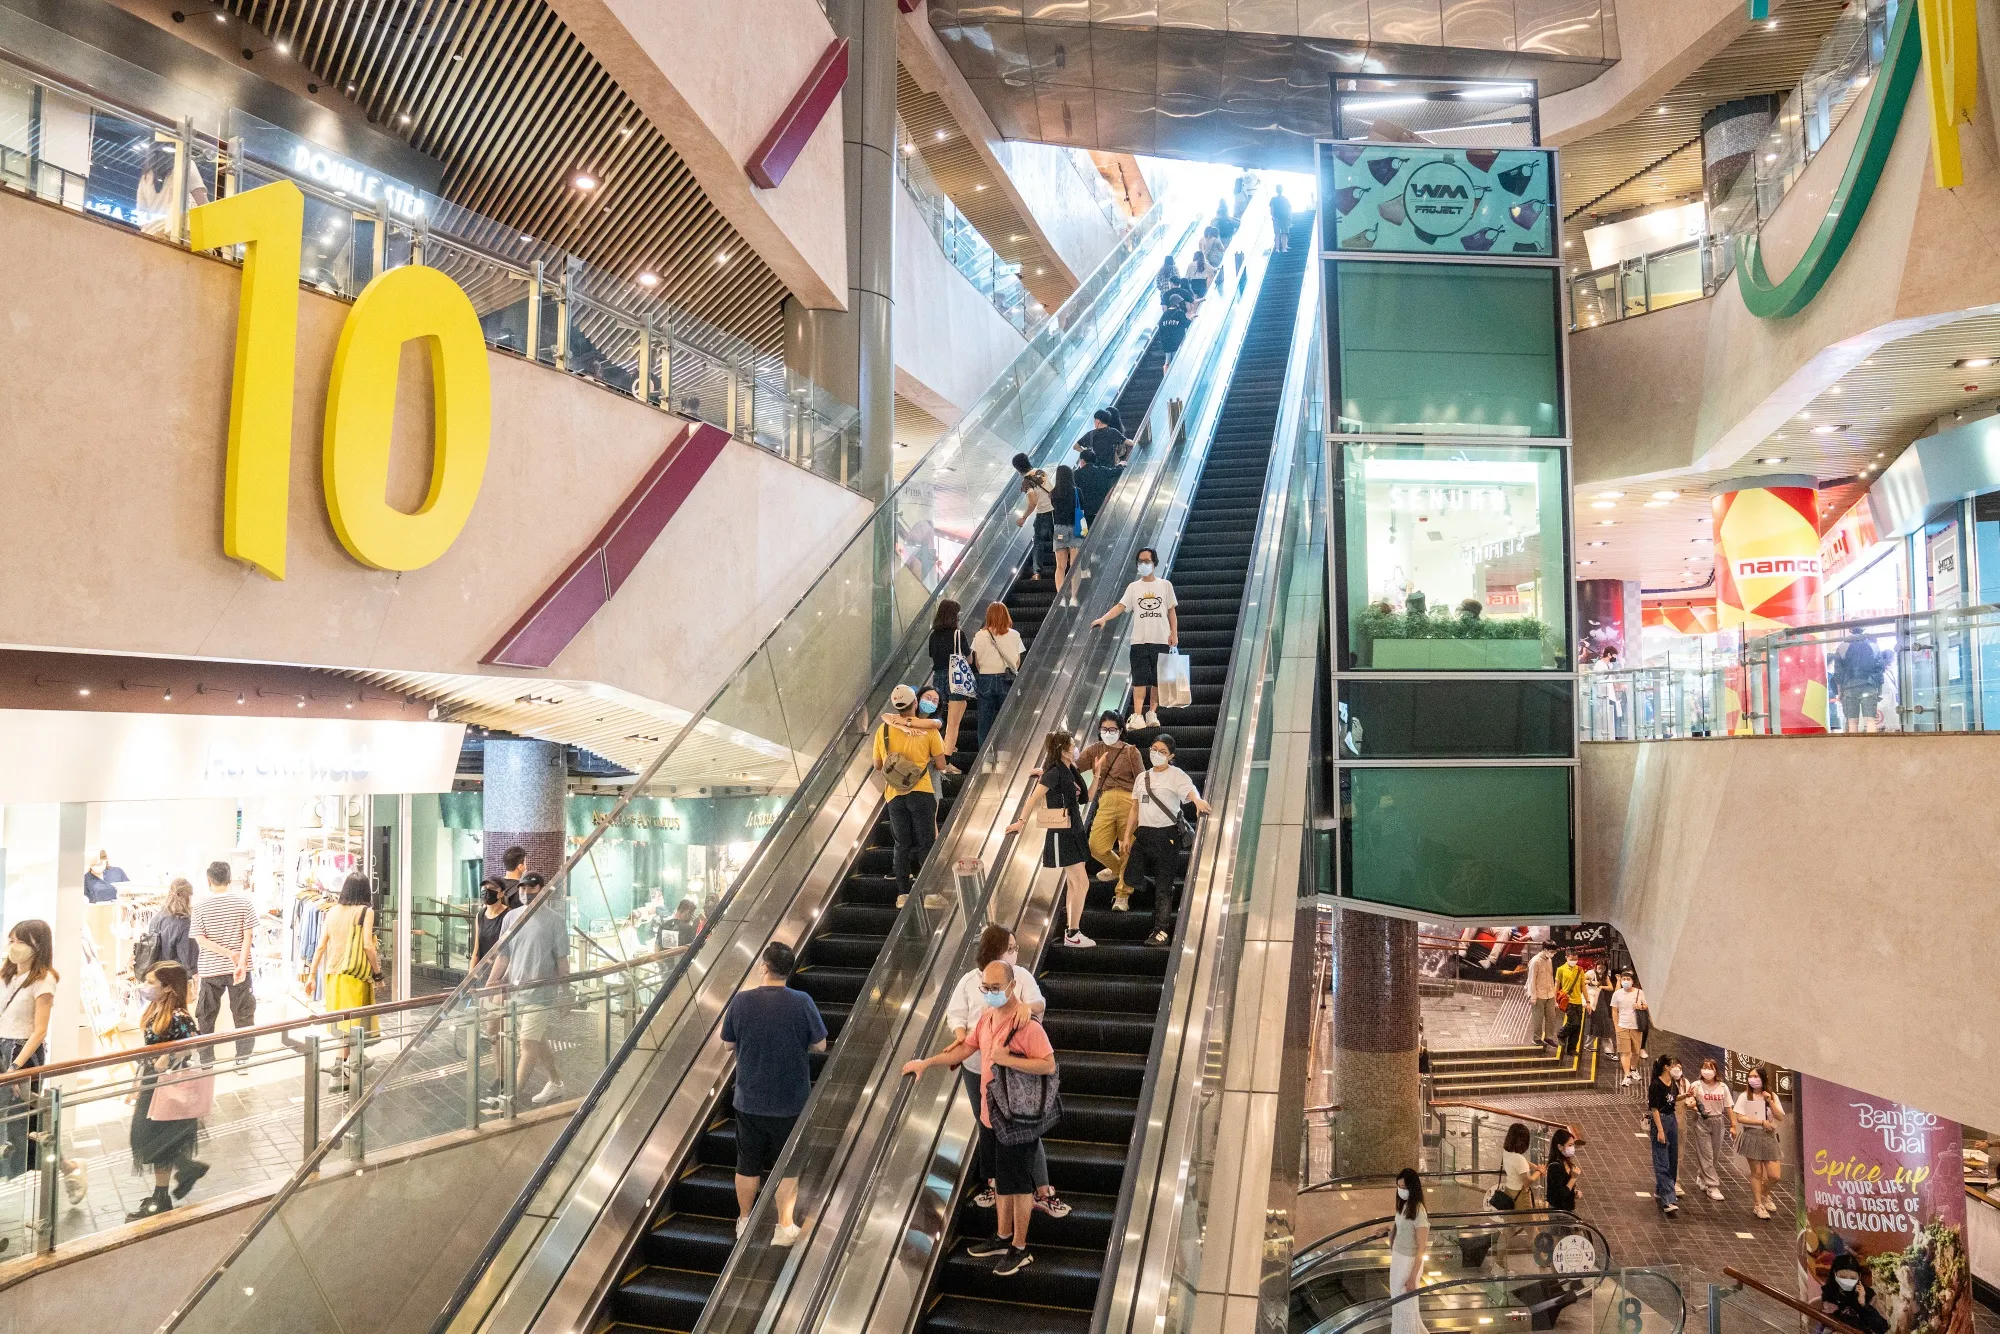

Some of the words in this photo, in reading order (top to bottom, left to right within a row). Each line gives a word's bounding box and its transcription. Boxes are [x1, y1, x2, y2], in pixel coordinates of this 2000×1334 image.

[1410, 183, 1469, 199] WM
[1414, 205, 1464, 215] PROJECT
[189, 179, 492, 582] 10
[1739, 559, 1819, 576] namco
[1139, 611, 1162, 619] adidas
[1573, 925, 1605, 942] 4DX
[1848, 1102, 1938, 1136] Bamboo
[1874, 1124, 1926, 1154] Thai
[1810, 1149, 1887, 1187] Spice
[1894, 1164, 1931, 1195] up
[1836, 1180, 1876, 1195] YOUR
[1878, 1180, 1907, 1195] LIFE
[1814, 1190, 1844, 1209] HAVE
[1846, 1195, 1857, 1210] A
[1859, 1197, 1901, 1213] TASTE
[1903, 1197, 1920, 1213] OF
[1826, 1206, 1909, 1233] MEKONG
[1617, 1297, 1643, 1334] 8
